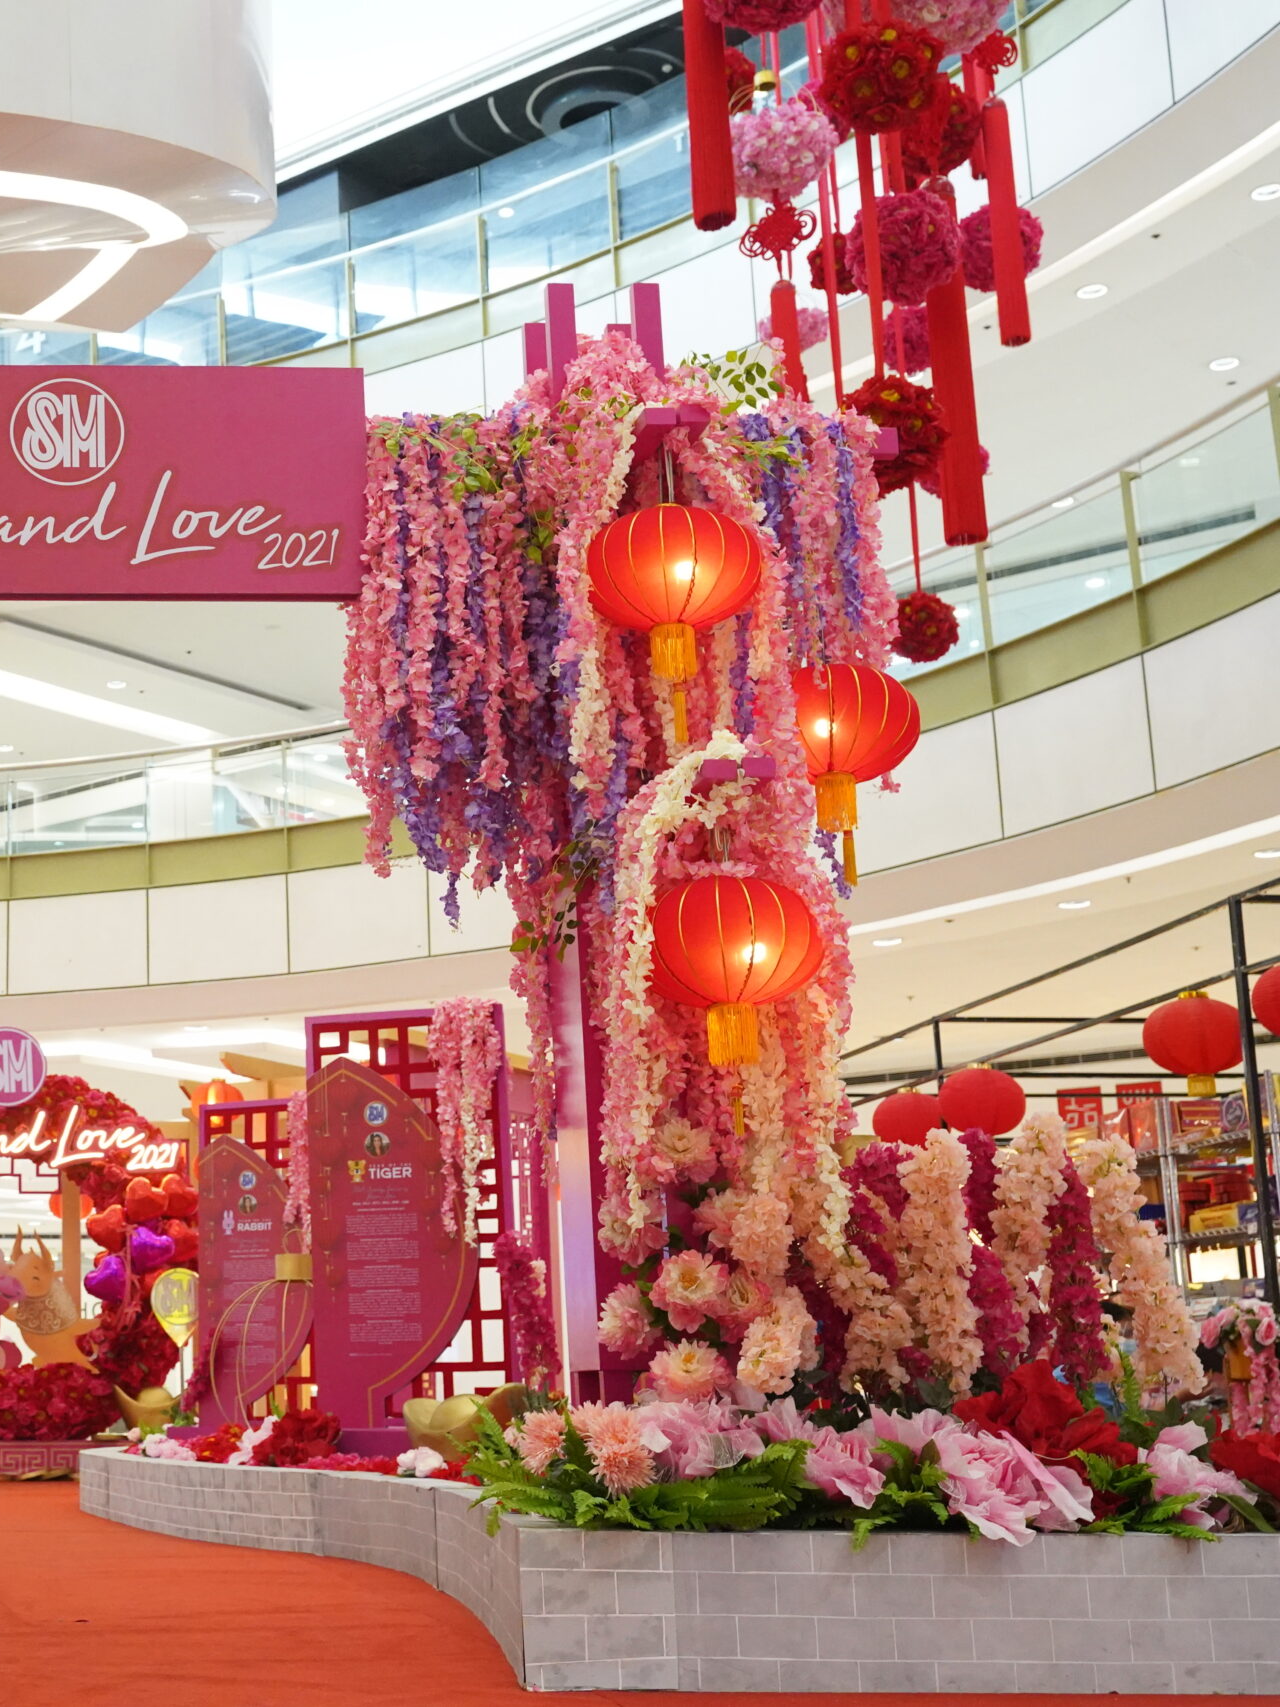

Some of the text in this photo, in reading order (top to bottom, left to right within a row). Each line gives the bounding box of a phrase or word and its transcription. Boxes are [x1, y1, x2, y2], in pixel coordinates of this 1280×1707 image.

[22, 391, 106, 470] SM
[131, 470, 284, 565] Love
[257, 529, 339, 570] 2021
[51, 1105, 145, 1167] Love
[128, 1141, 179, 1171] 2021
[368, 1166, 412, 1179] TIGER
[237, 1221, 272, 1232] RABBIT
